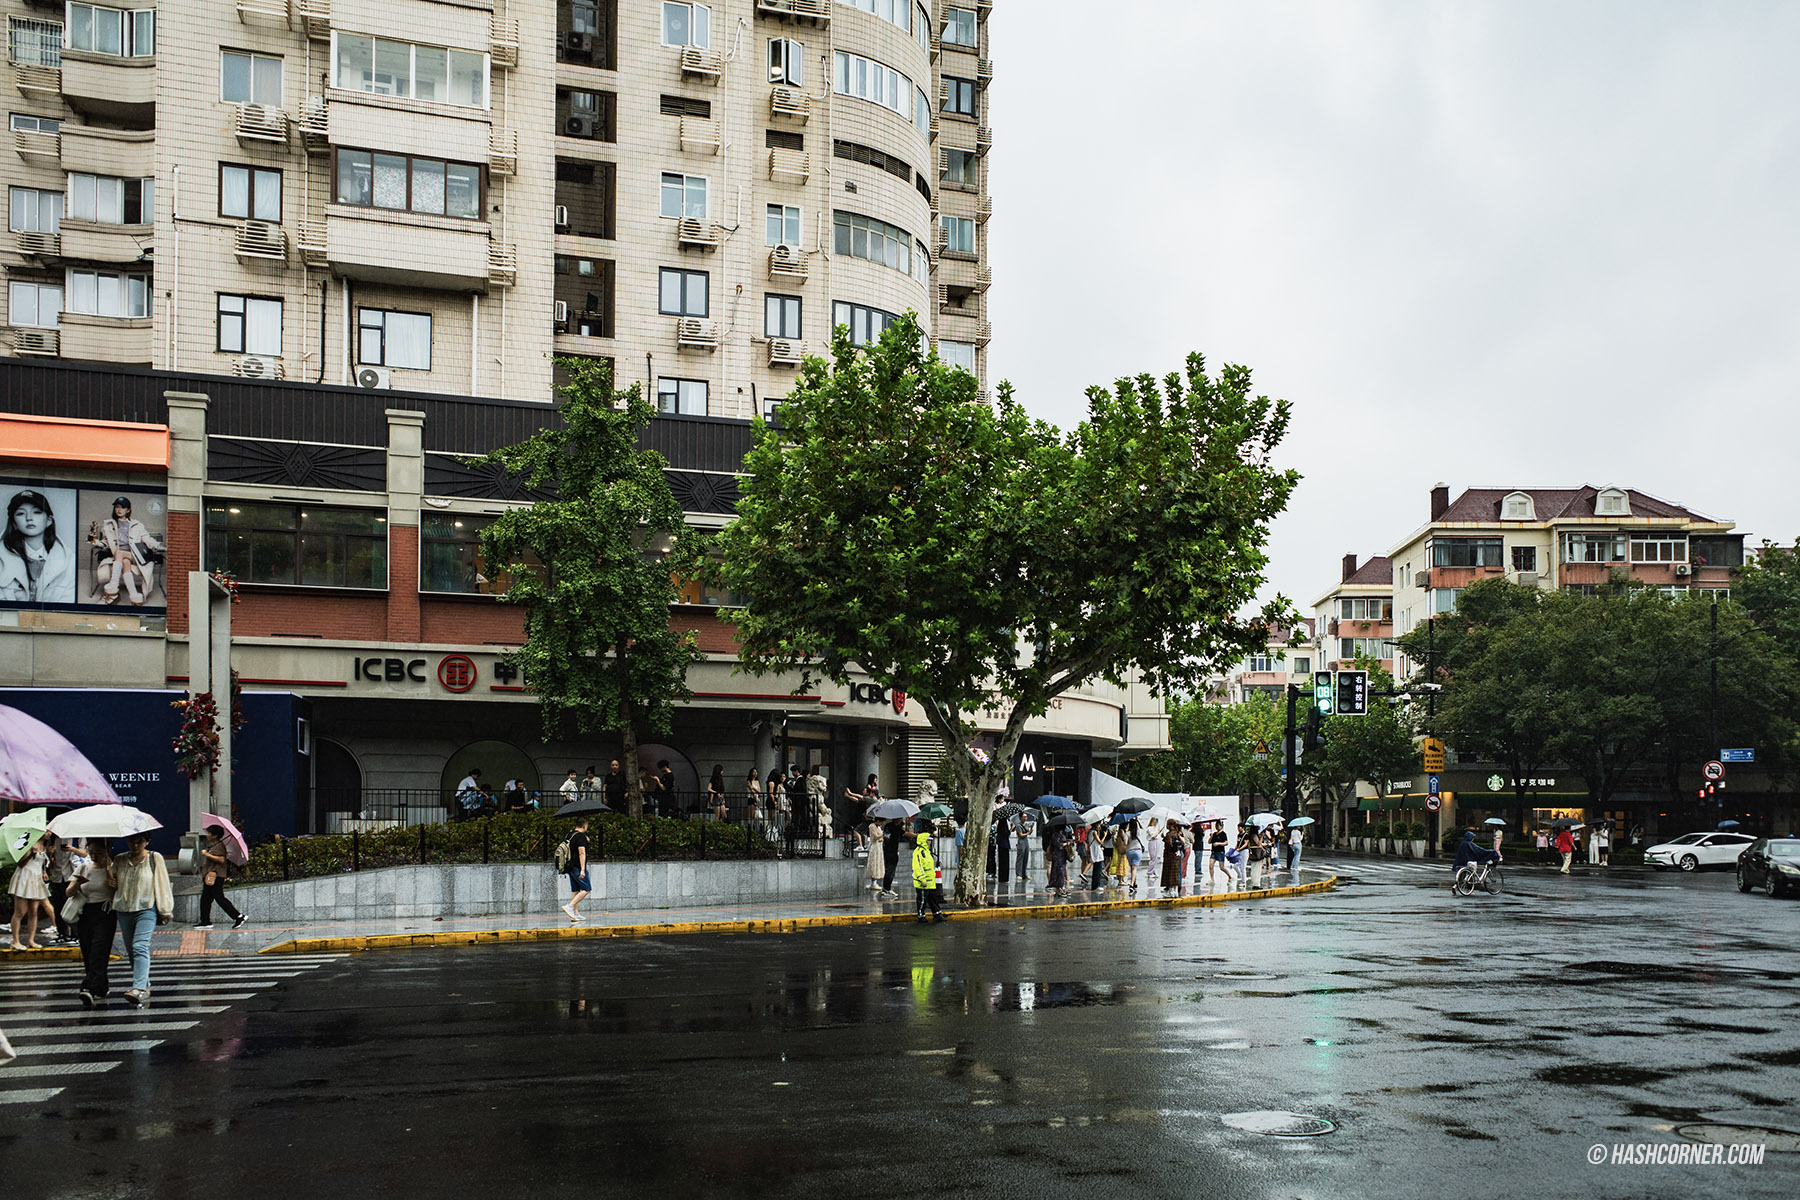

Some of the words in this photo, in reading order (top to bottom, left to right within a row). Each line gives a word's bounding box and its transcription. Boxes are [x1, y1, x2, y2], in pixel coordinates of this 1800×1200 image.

[354, 657, 426, 682] ICBC
[850, 682, 891, 705] ICBC
[1317, 686, 1330, 698] 08
[1355, 675, 1363, 710] 右转控制
[1019, 753, 1036, 772] M
[109, 772, 160, 782] WEENIE
